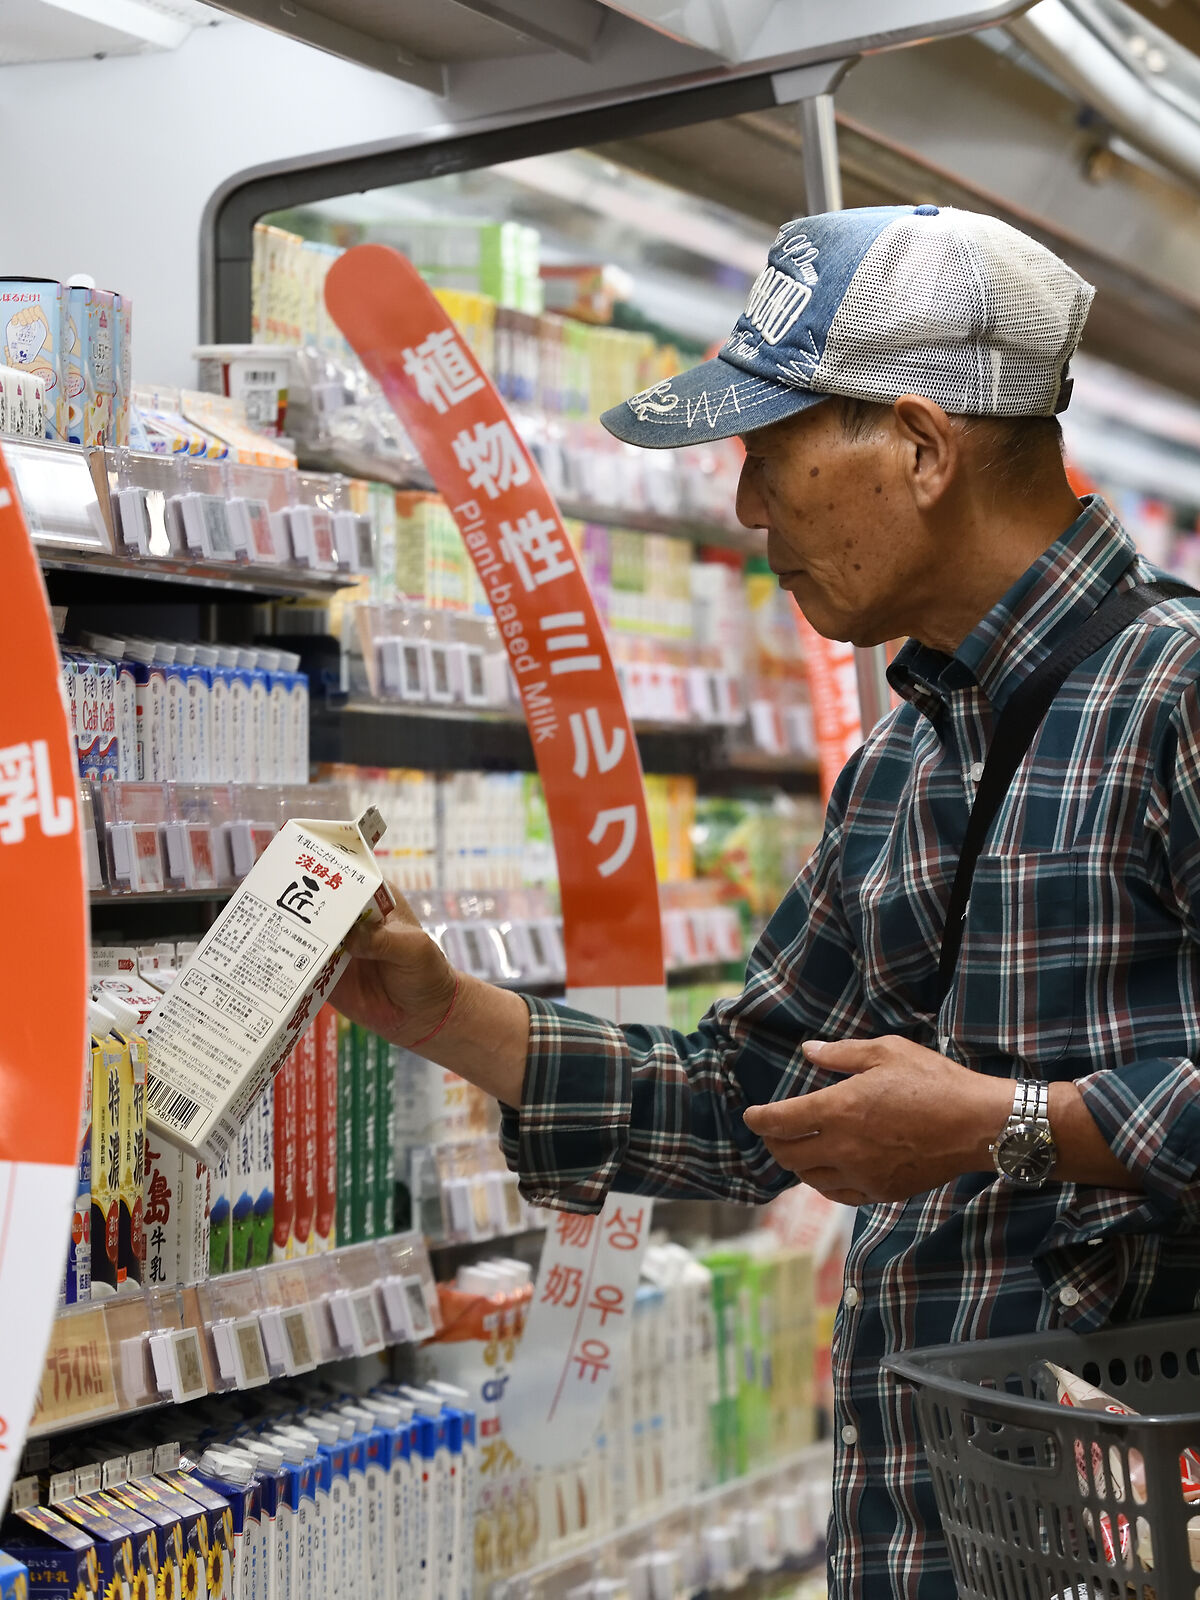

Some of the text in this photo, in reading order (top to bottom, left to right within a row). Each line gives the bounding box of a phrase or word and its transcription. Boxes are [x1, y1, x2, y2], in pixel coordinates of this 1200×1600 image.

[744, 265, 813, 346] OUND
[402, 327, 638, 877] 植物性ミルク
[454, 500, 560, 744] Plant-based Milk
[295, 833, 367, 884] 牛乳にこだわった牛乳
[295, 853, 344, 890] 淡路島
[276, 875, 320, 925] 匠
[295, 955, 307, 969] 公正
[149, 1226, 166, 1284] 牛乳
[573, 1283, 625, 1383] 우유
